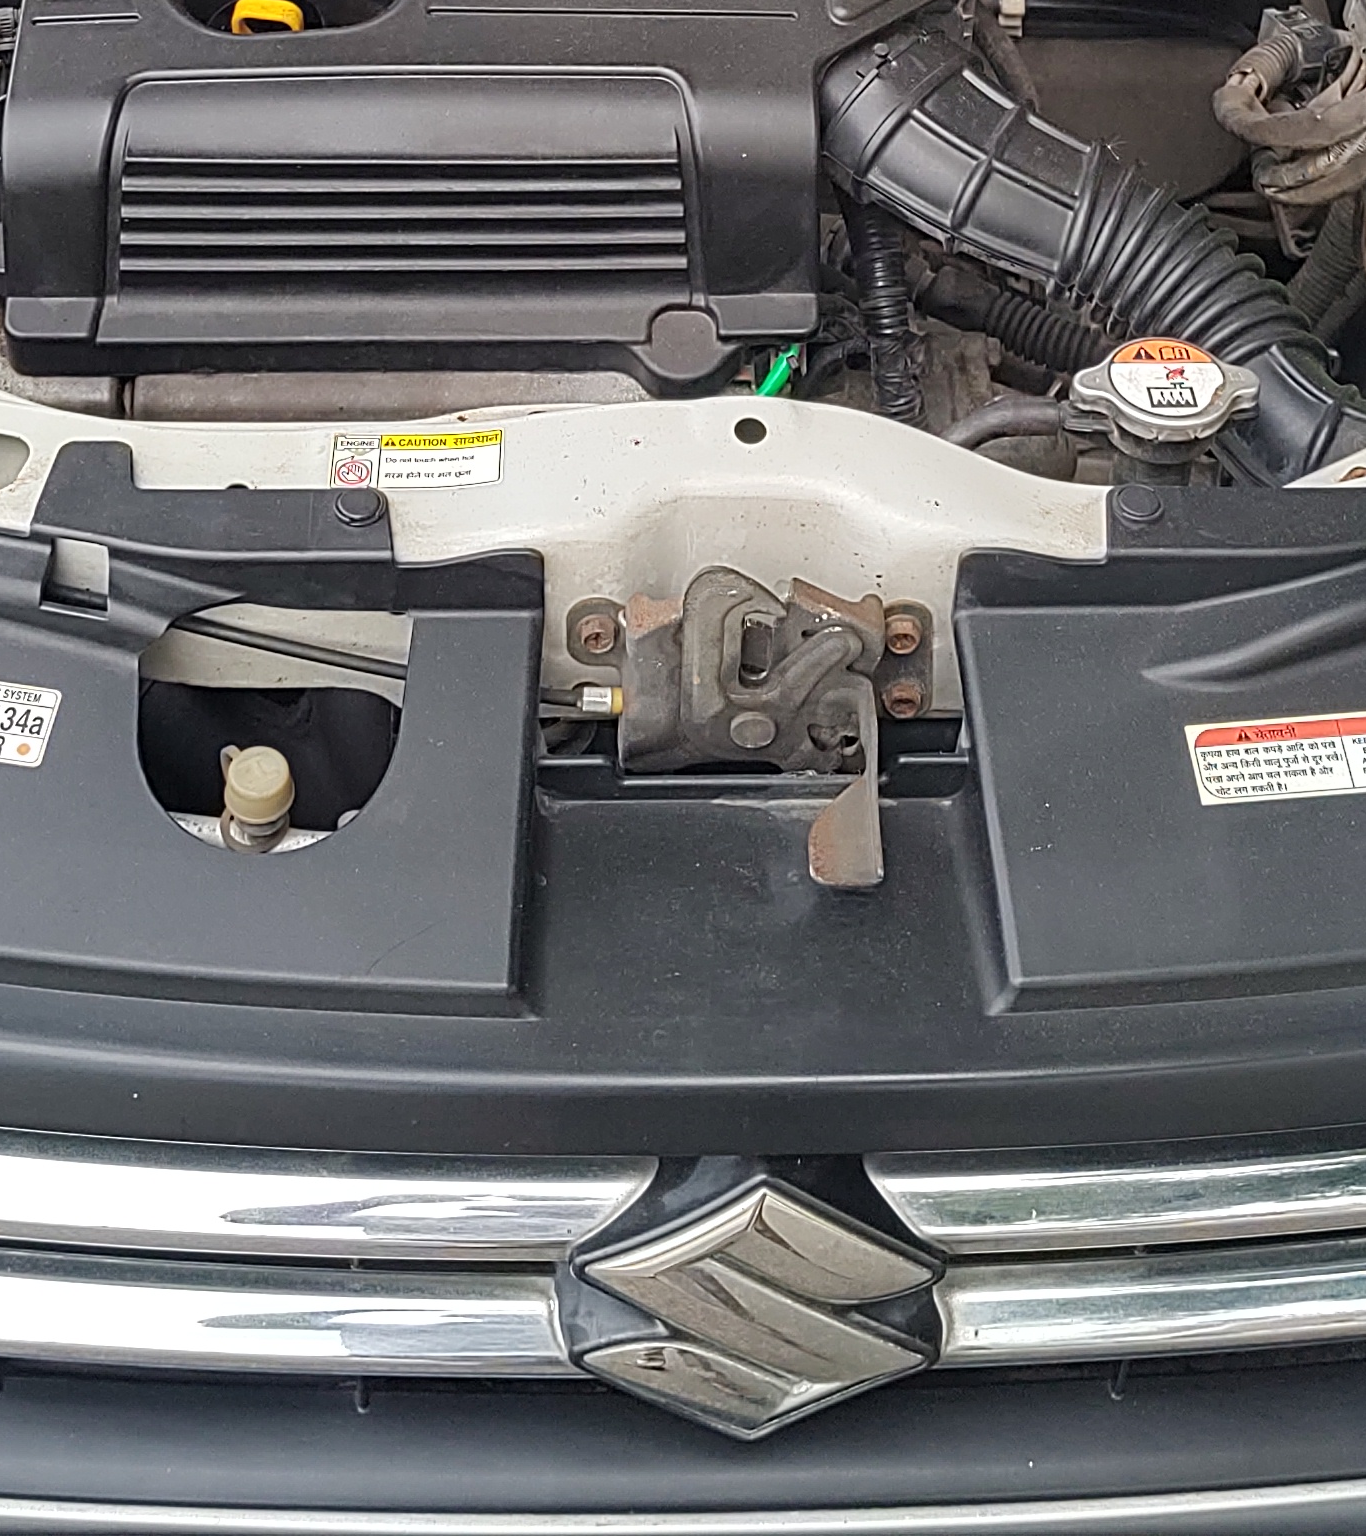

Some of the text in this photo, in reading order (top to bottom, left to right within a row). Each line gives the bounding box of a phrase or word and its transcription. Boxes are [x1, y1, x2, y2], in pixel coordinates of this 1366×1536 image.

[399, 433, 499, 447] CAUTION सावधान
[3, 688, 41, 703] SYSTEM
[1255, 725, 1297, 740] चेतावनी
[1200, 750, 1222, 762] कृपया
[1244, 747, 1259, 755] बाल
[1286, 741, 1304, 752] आदि
[1308, 741, 1319, 750] को
[1203, 762, 1218, 771] और
[1221, 762, 1237, 770] अन्य
[1240, 758, 1261, 768] किसी
[1311, 755, 1322, 765] दूर
[1226, 772, 1245, 782] अपने
[1248, 772, 1263, 780] आप
[1266, 770, 1281, 778] चल
[1285, 768, 1307, 777] सकता
[1310, 766, 1317, 776] है
[1319, 766, 1334, 775] और
[1216, 787, 1231, 795] चोट
[1234, 786, 1248, 794] लग
[1252, 783, 1274, 793] सकती
